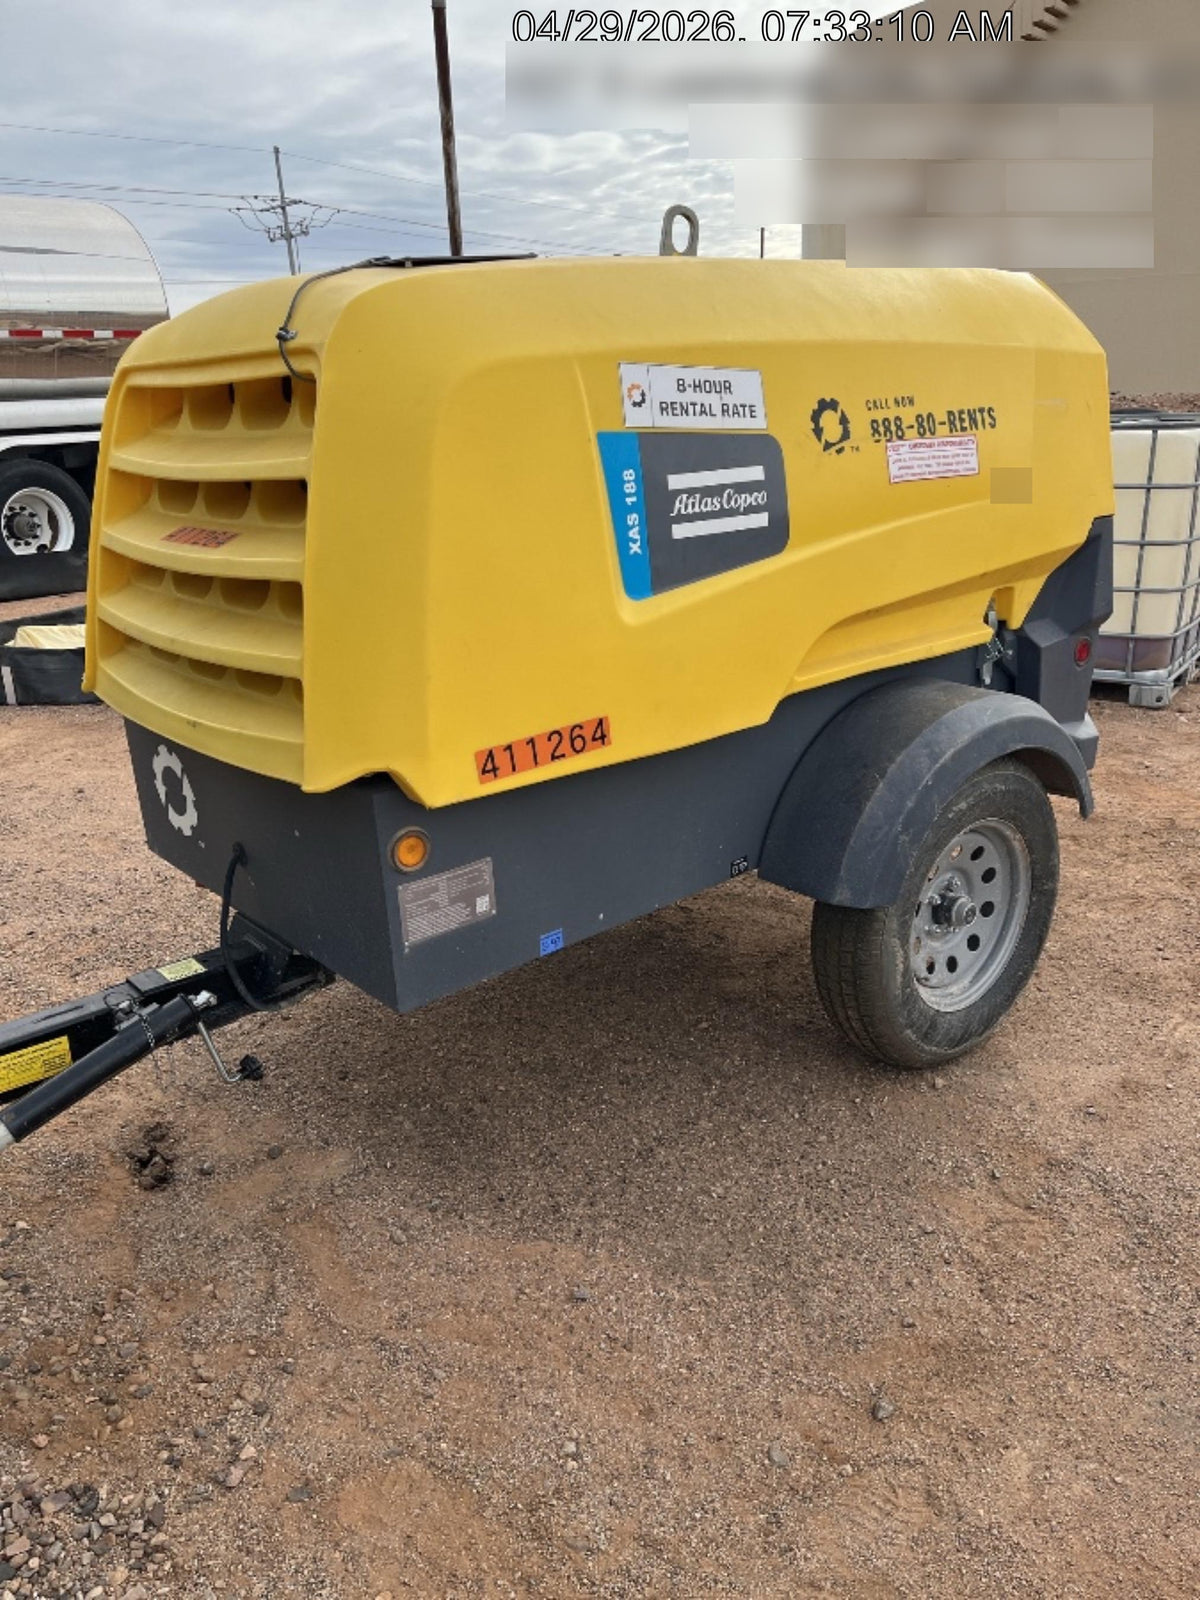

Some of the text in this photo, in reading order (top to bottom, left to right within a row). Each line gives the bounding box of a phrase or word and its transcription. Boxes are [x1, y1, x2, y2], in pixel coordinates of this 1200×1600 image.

[676, 378, 733, 395] 8-HOUR
[659, 400, 757, 419] RENTAL RATE
[865, 395, 915, 411] CALL NOW
[870, 406, 997, 443] 888-80-RENTS
[623, 468, 642, 555] XAS 188
[481, 717, 608, 778] 411264
